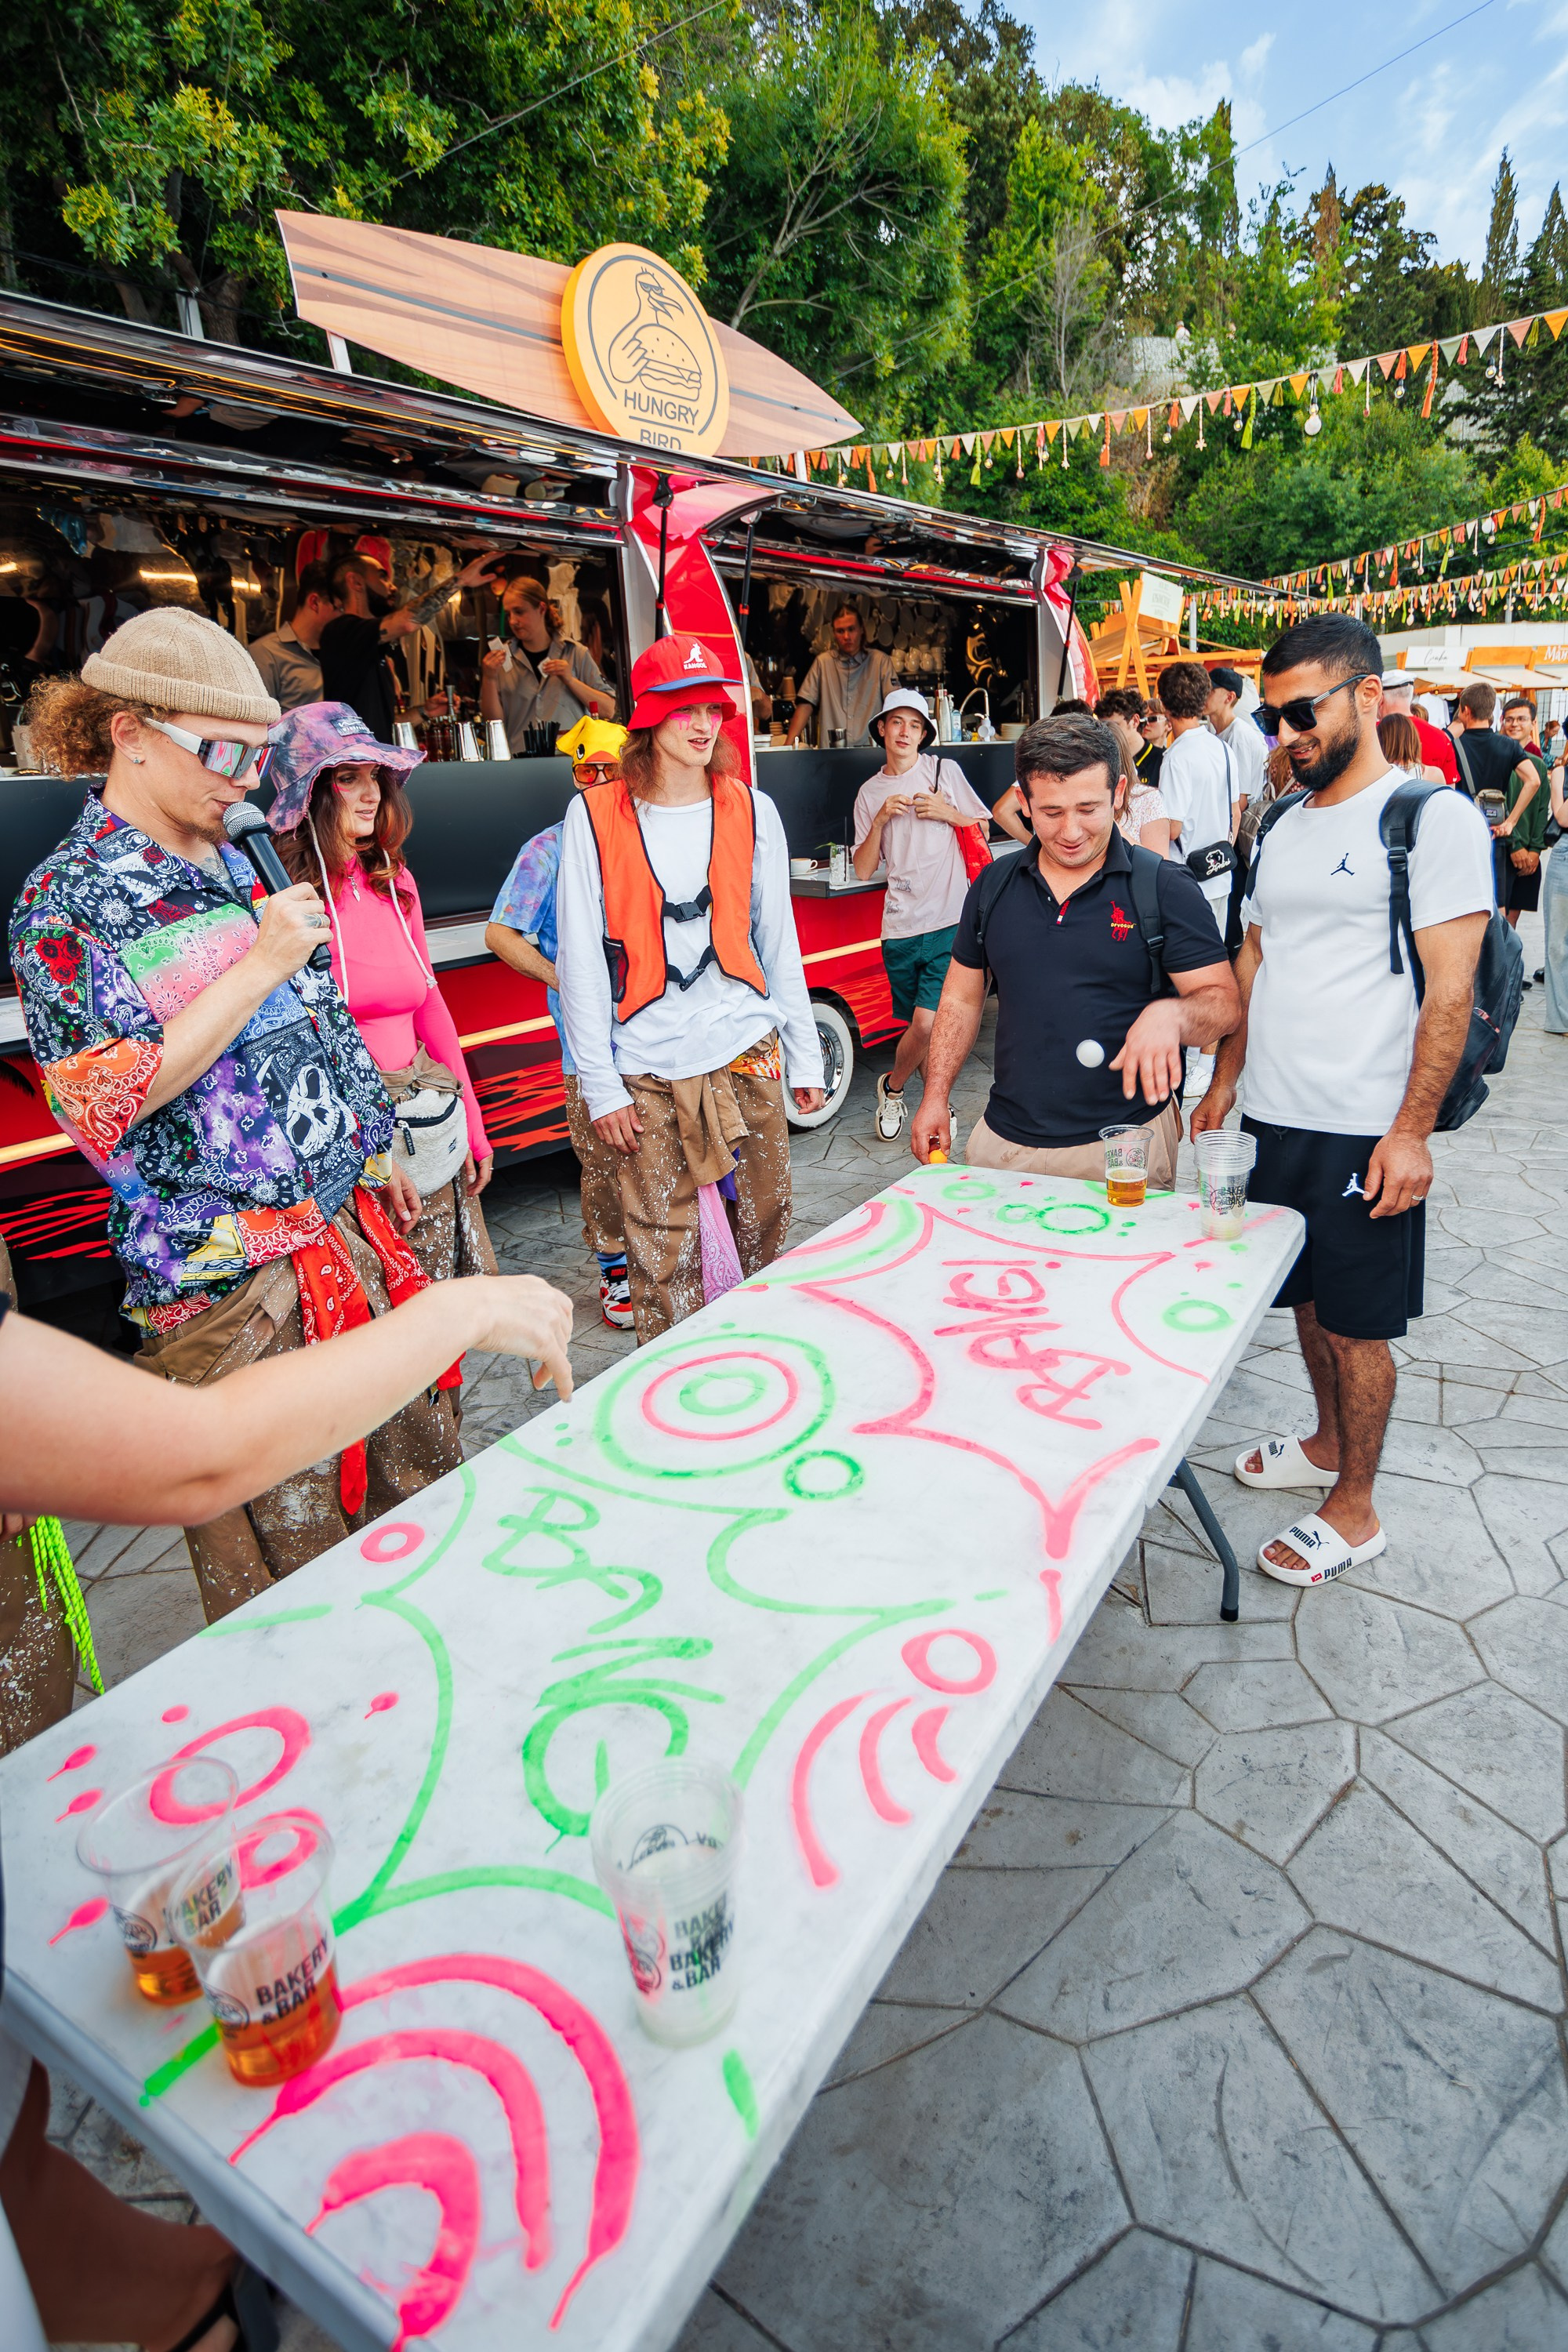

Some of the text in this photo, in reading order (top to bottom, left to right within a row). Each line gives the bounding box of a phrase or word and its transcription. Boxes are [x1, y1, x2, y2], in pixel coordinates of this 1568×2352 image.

[624, 389, 699, 426] HUNGRY
[640, 428, 681, 450] BIRD
[683, 662, 707, 670] KANGOL
[610, 1268, 626, 1277] NIKE
[933, 1260, 1131, 1430] BANG!
[1268, 1440, 1278, 1456] PUMA
[1289, 1526, 1316, 1548] PUMA
[1324, 1557, 1352, 1580] PUMA
[256, 1929, 328, 2006] BAKERY
